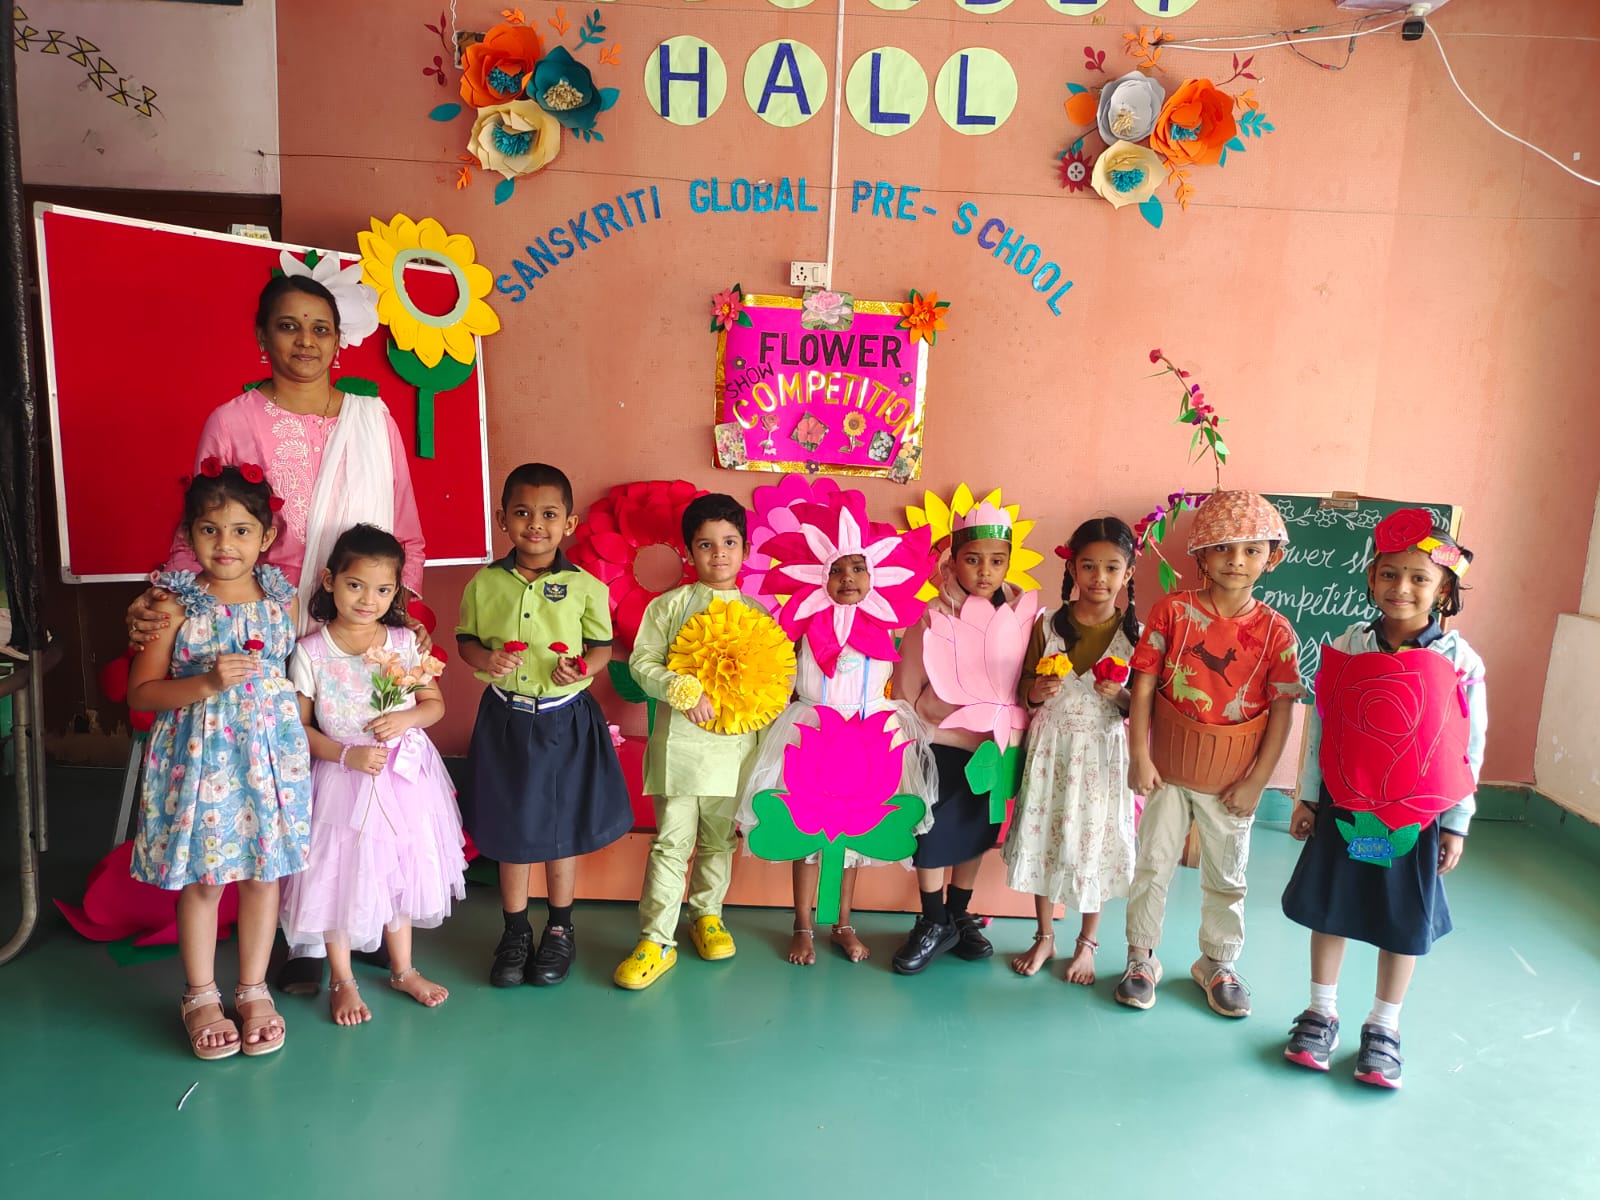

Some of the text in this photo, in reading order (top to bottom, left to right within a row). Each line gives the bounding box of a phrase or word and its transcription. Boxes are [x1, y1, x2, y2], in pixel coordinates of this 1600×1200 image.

[659, 43, 996, 125] HALL
[496, 185, 661, 303] SANSKRITI
[689, 177, 818, 213] GLOBAL
[952, 201, 1074, 317] SCHOOL
[759, 331, 902, 368] FLOWER
[726, 361, 774, 399] SHOW
[732, 370, 924, 446] COMPETITION
[1281, 545, 1336, 569] ower
